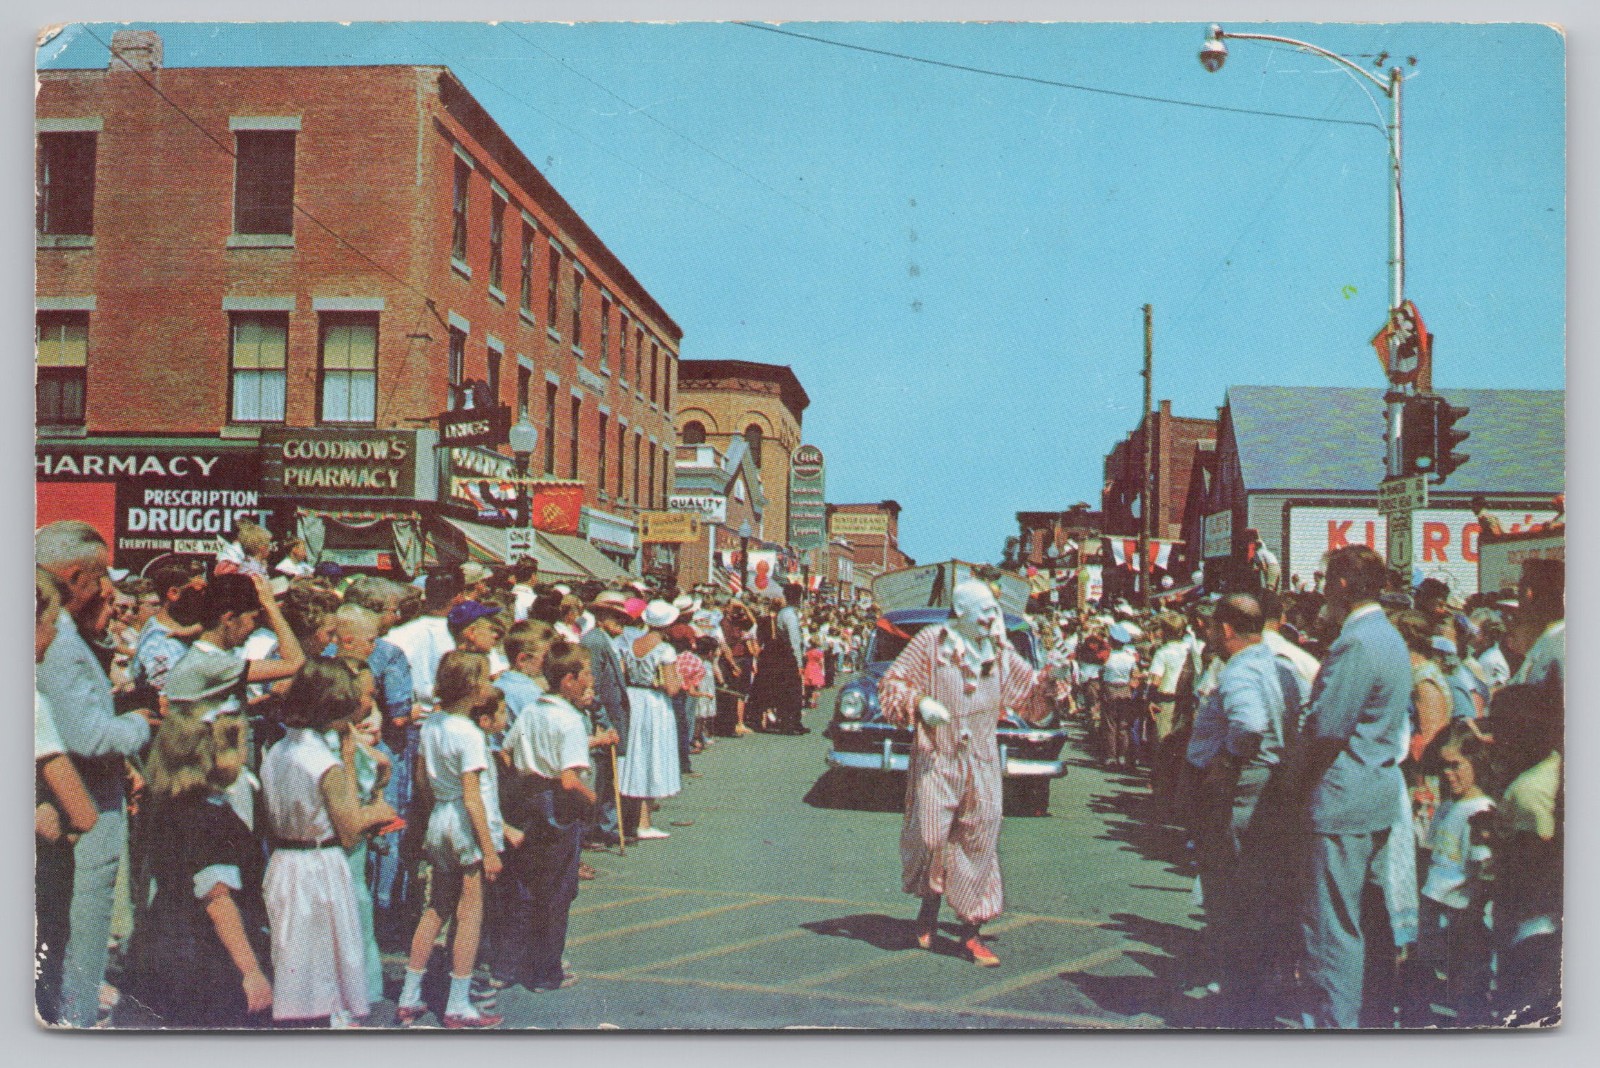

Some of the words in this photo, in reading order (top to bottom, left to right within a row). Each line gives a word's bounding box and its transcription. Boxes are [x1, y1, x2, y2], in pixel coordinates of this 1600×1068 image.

[283, 436, 407, 459] GOODNOW'S
[284, 467, 399, 488] PHARMACY
[144, 489, 258, 507] PRESCRIPTION
[671, 497, 722, 508] QUALITY
